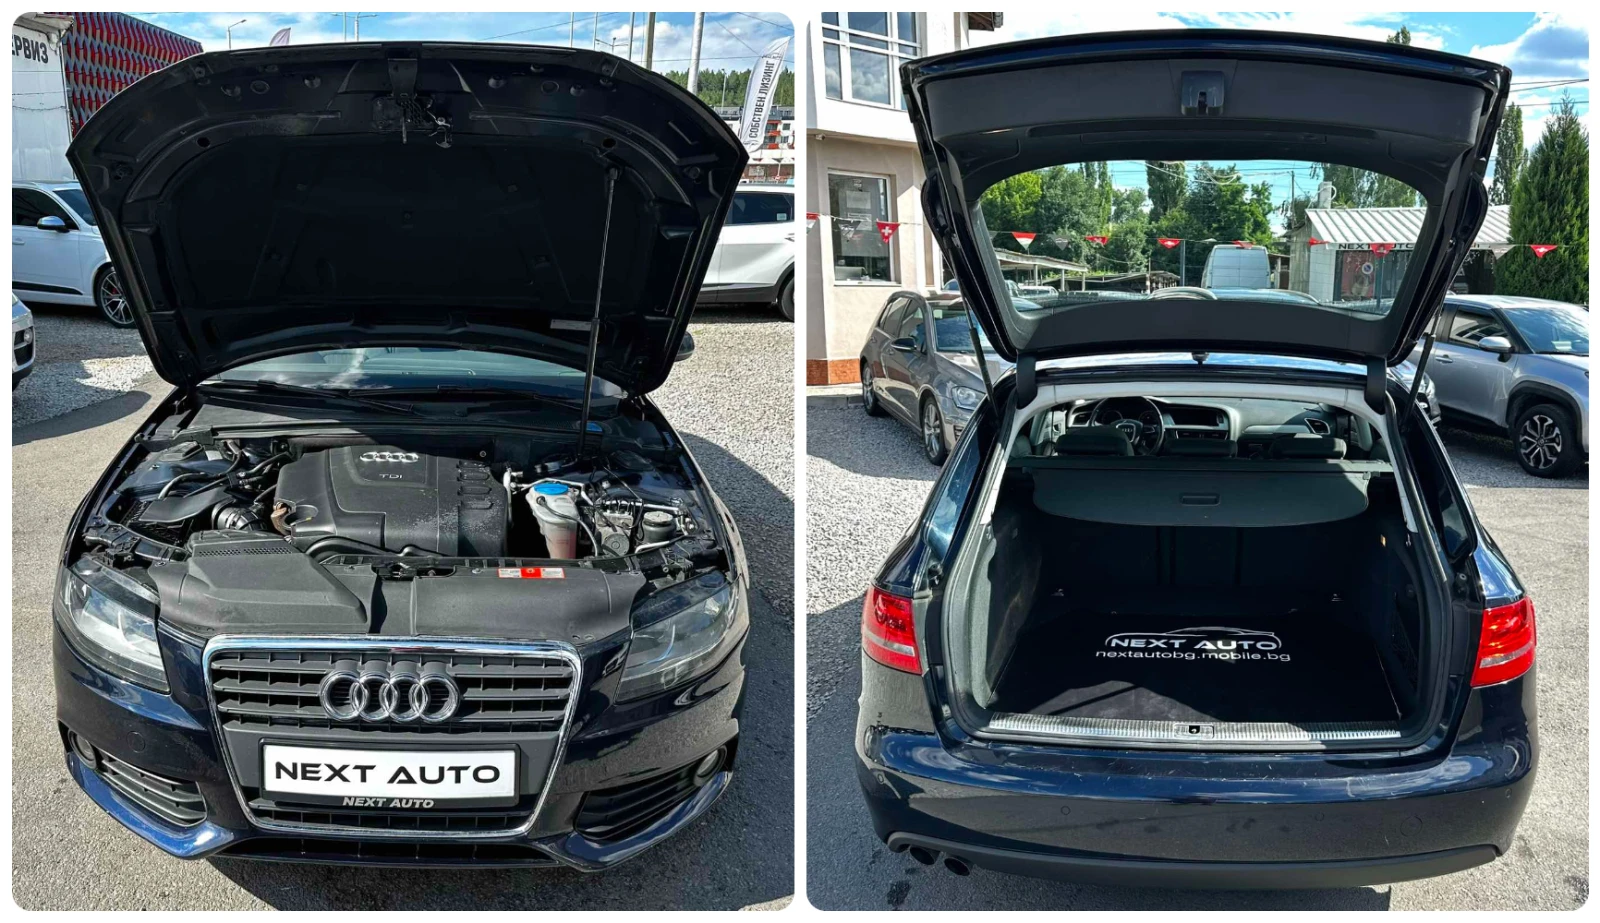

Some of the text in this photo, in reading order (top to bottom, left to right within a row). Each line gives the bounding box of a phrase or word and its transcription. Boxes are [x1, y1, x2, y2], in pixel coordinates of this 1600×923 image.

[749, 97, 765, 139] СОБСТВЕН
[758, 60, 775, 96] ЛИЗИНГ
[1111, 638, 1277, 650] NEXT AUTO
[1095, 650, 1291, 662] nextautobg.mobile.bg
[275, 761, 501, 784] NEXT AUTO
[343, 796, 435, 809] NEXT AUTO
